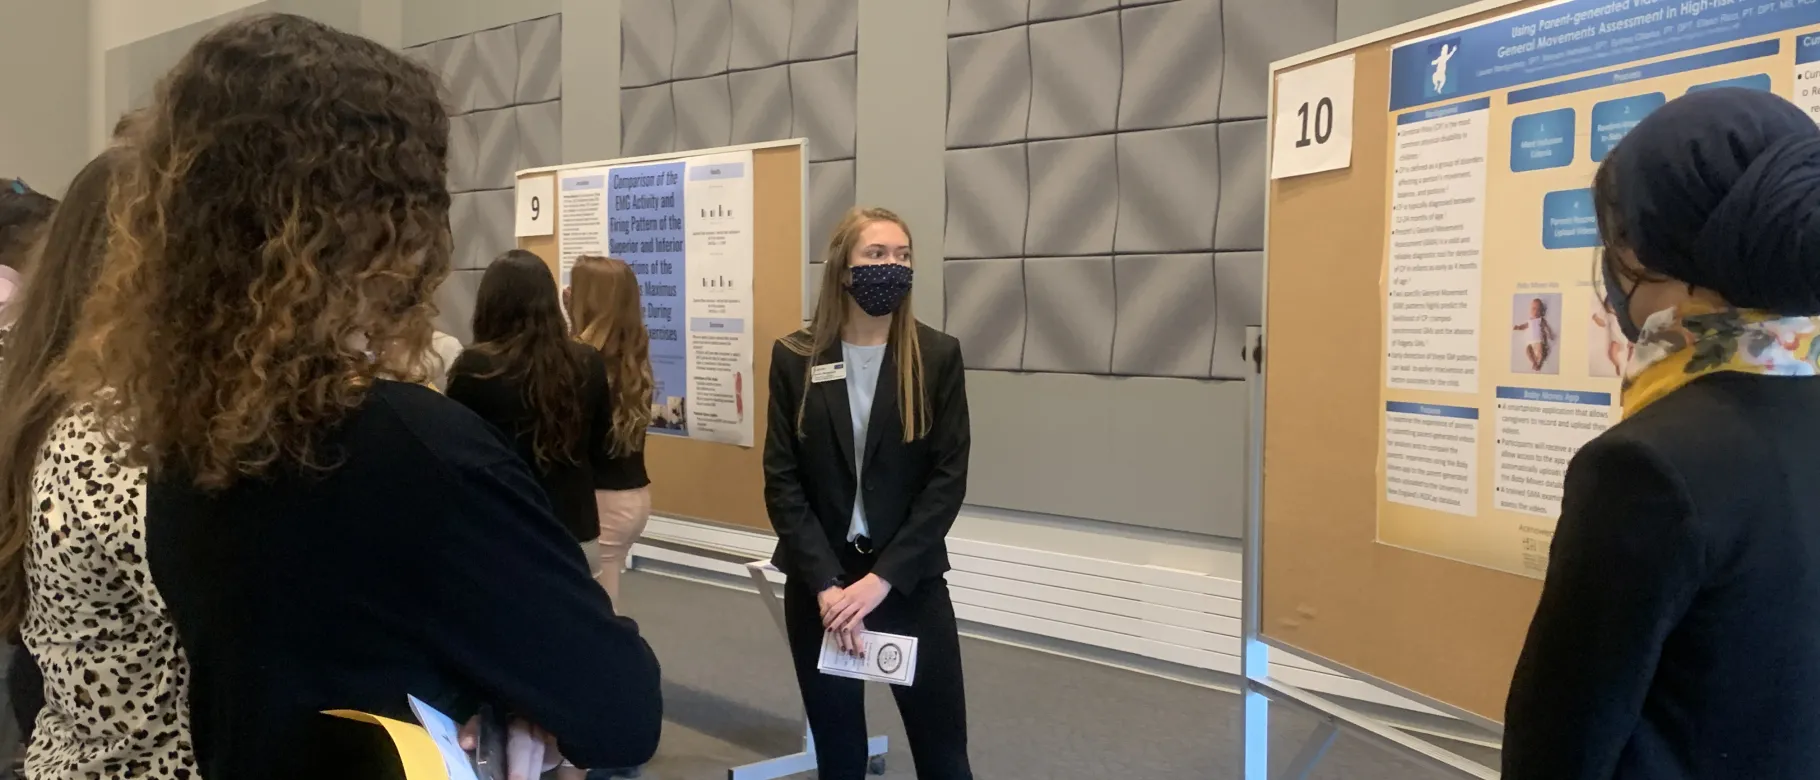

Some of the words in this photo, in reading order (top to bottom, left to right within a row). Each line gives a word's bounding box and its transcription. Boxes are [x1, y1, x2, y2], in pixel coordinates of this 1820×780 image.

[1511, 24, 1536, 38] Using
[1539, 0, 1630, 31] Parent-generated
[1497, 37, 1536, 58] General
[1537, 25, 1596, 51] Movements
[1598, 7, 1663, 34] Assessment
[1666, 7, 1677, 20] in
[1296, 96, 1333, 148] 10
[614, 173, 655, 191] Comparison
[656, 171, 665, 186] of
[666, 170, 678, 186] the
[531, 196, 540, 221] 9
[615, 194, 631, 211] EMG
[632, 193, 659, 211] Activity
[661, 192, 675, 208] and
[610, 217, 630, 235] Firing
[631, 215, 658, 232] Pattern
[660, 215, 667, 231] of
[669, 214, 682, 230] the
[609, 238, 639, 256] Superior
[640, 237, 654, 253] and
[655, 236, 684, 253] Inferior
[651, 260, 658, 275] of
[660, 259, 672, 275] the
[644, 281, 677, 297] Maximus
[647, 302, 672, 322] During
[1575, 408, 1588, 416] that
[1589, 409, 1608, 419] allows
[1558, 420, 1569, 428] and
[1543, 455, 1552, 463] the
